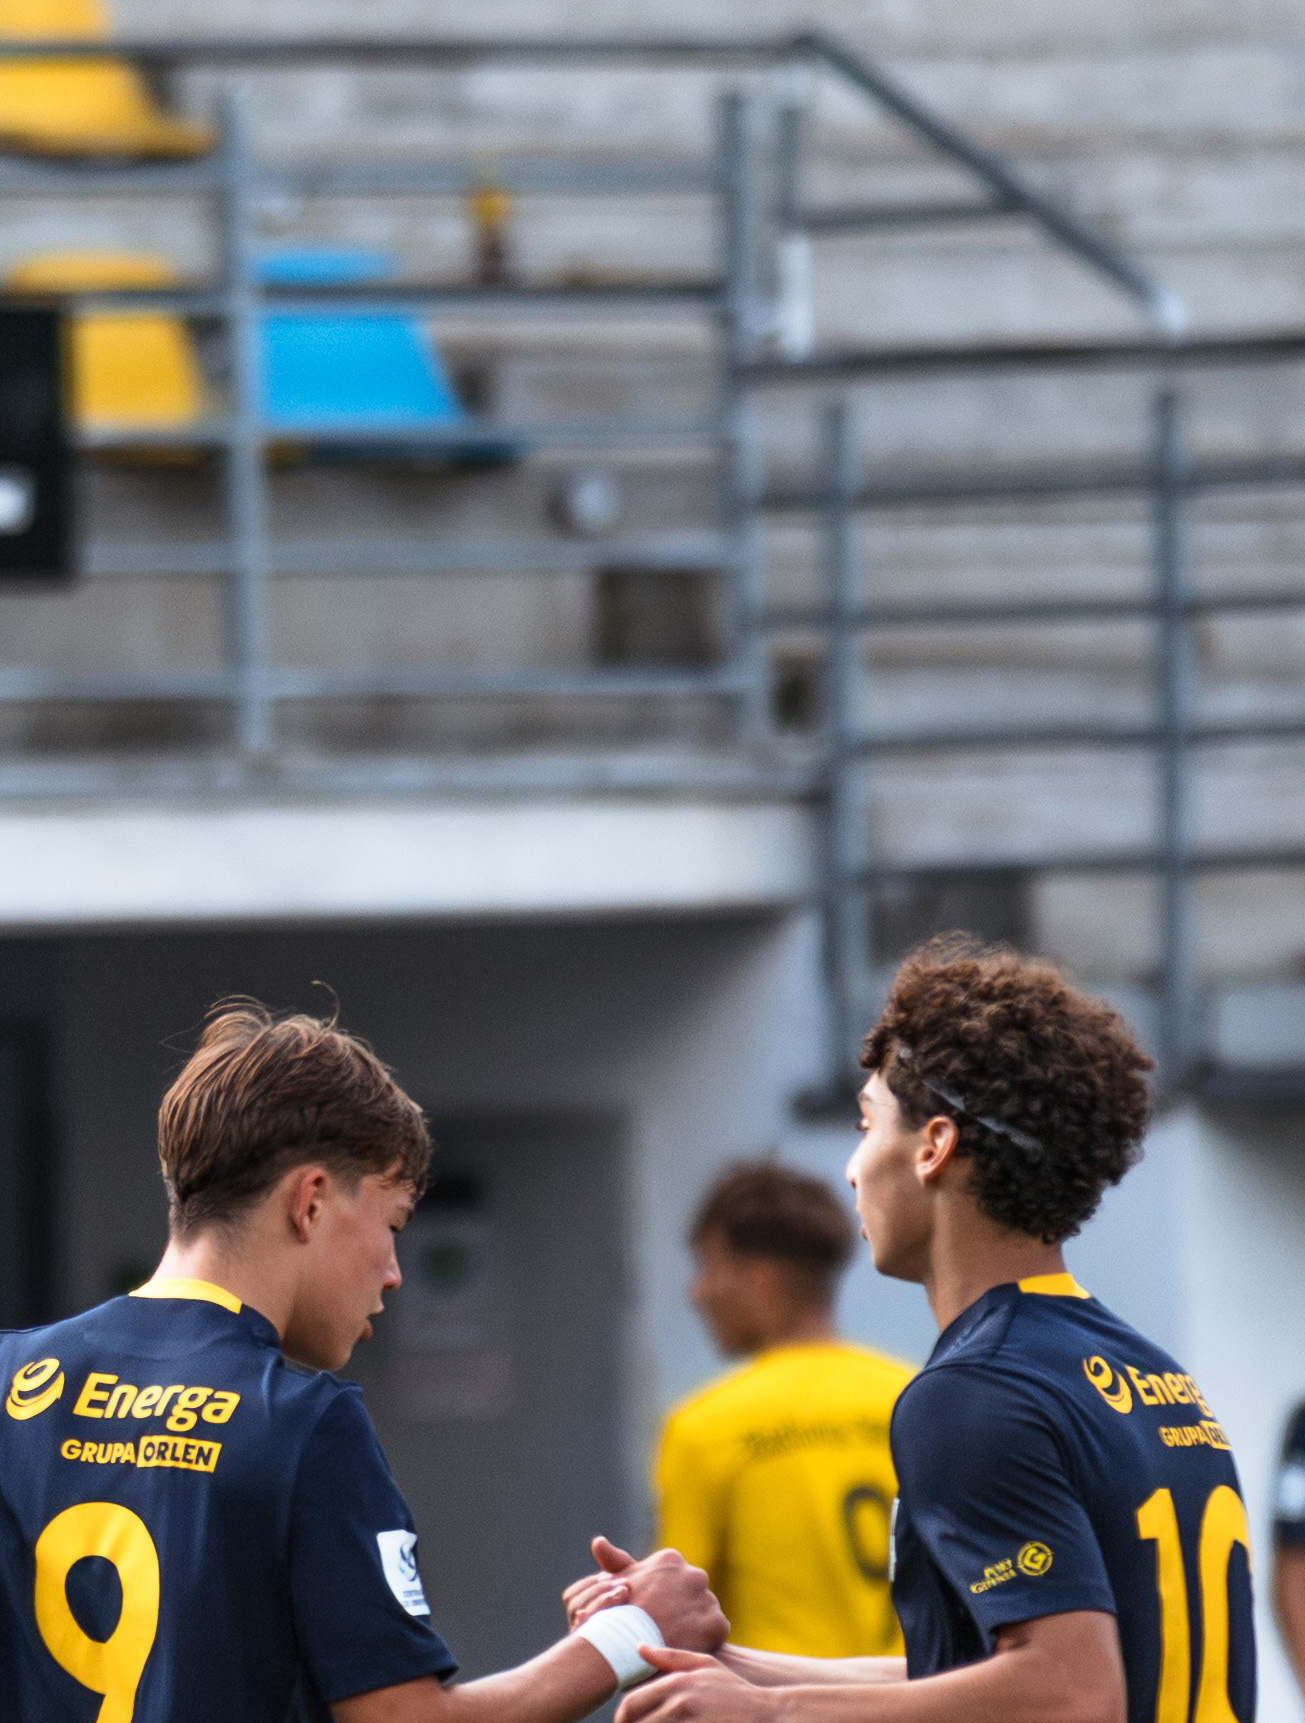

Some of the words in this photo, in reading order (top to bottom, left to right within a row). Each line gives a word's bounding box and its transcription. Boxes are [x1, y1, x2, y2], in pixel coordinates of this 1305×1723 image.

[72, 1371, 241, 1432] Energa
[61, 1438, 136, 1464] GRUPA
[142, 1441, 214, 1467] ORLEN
